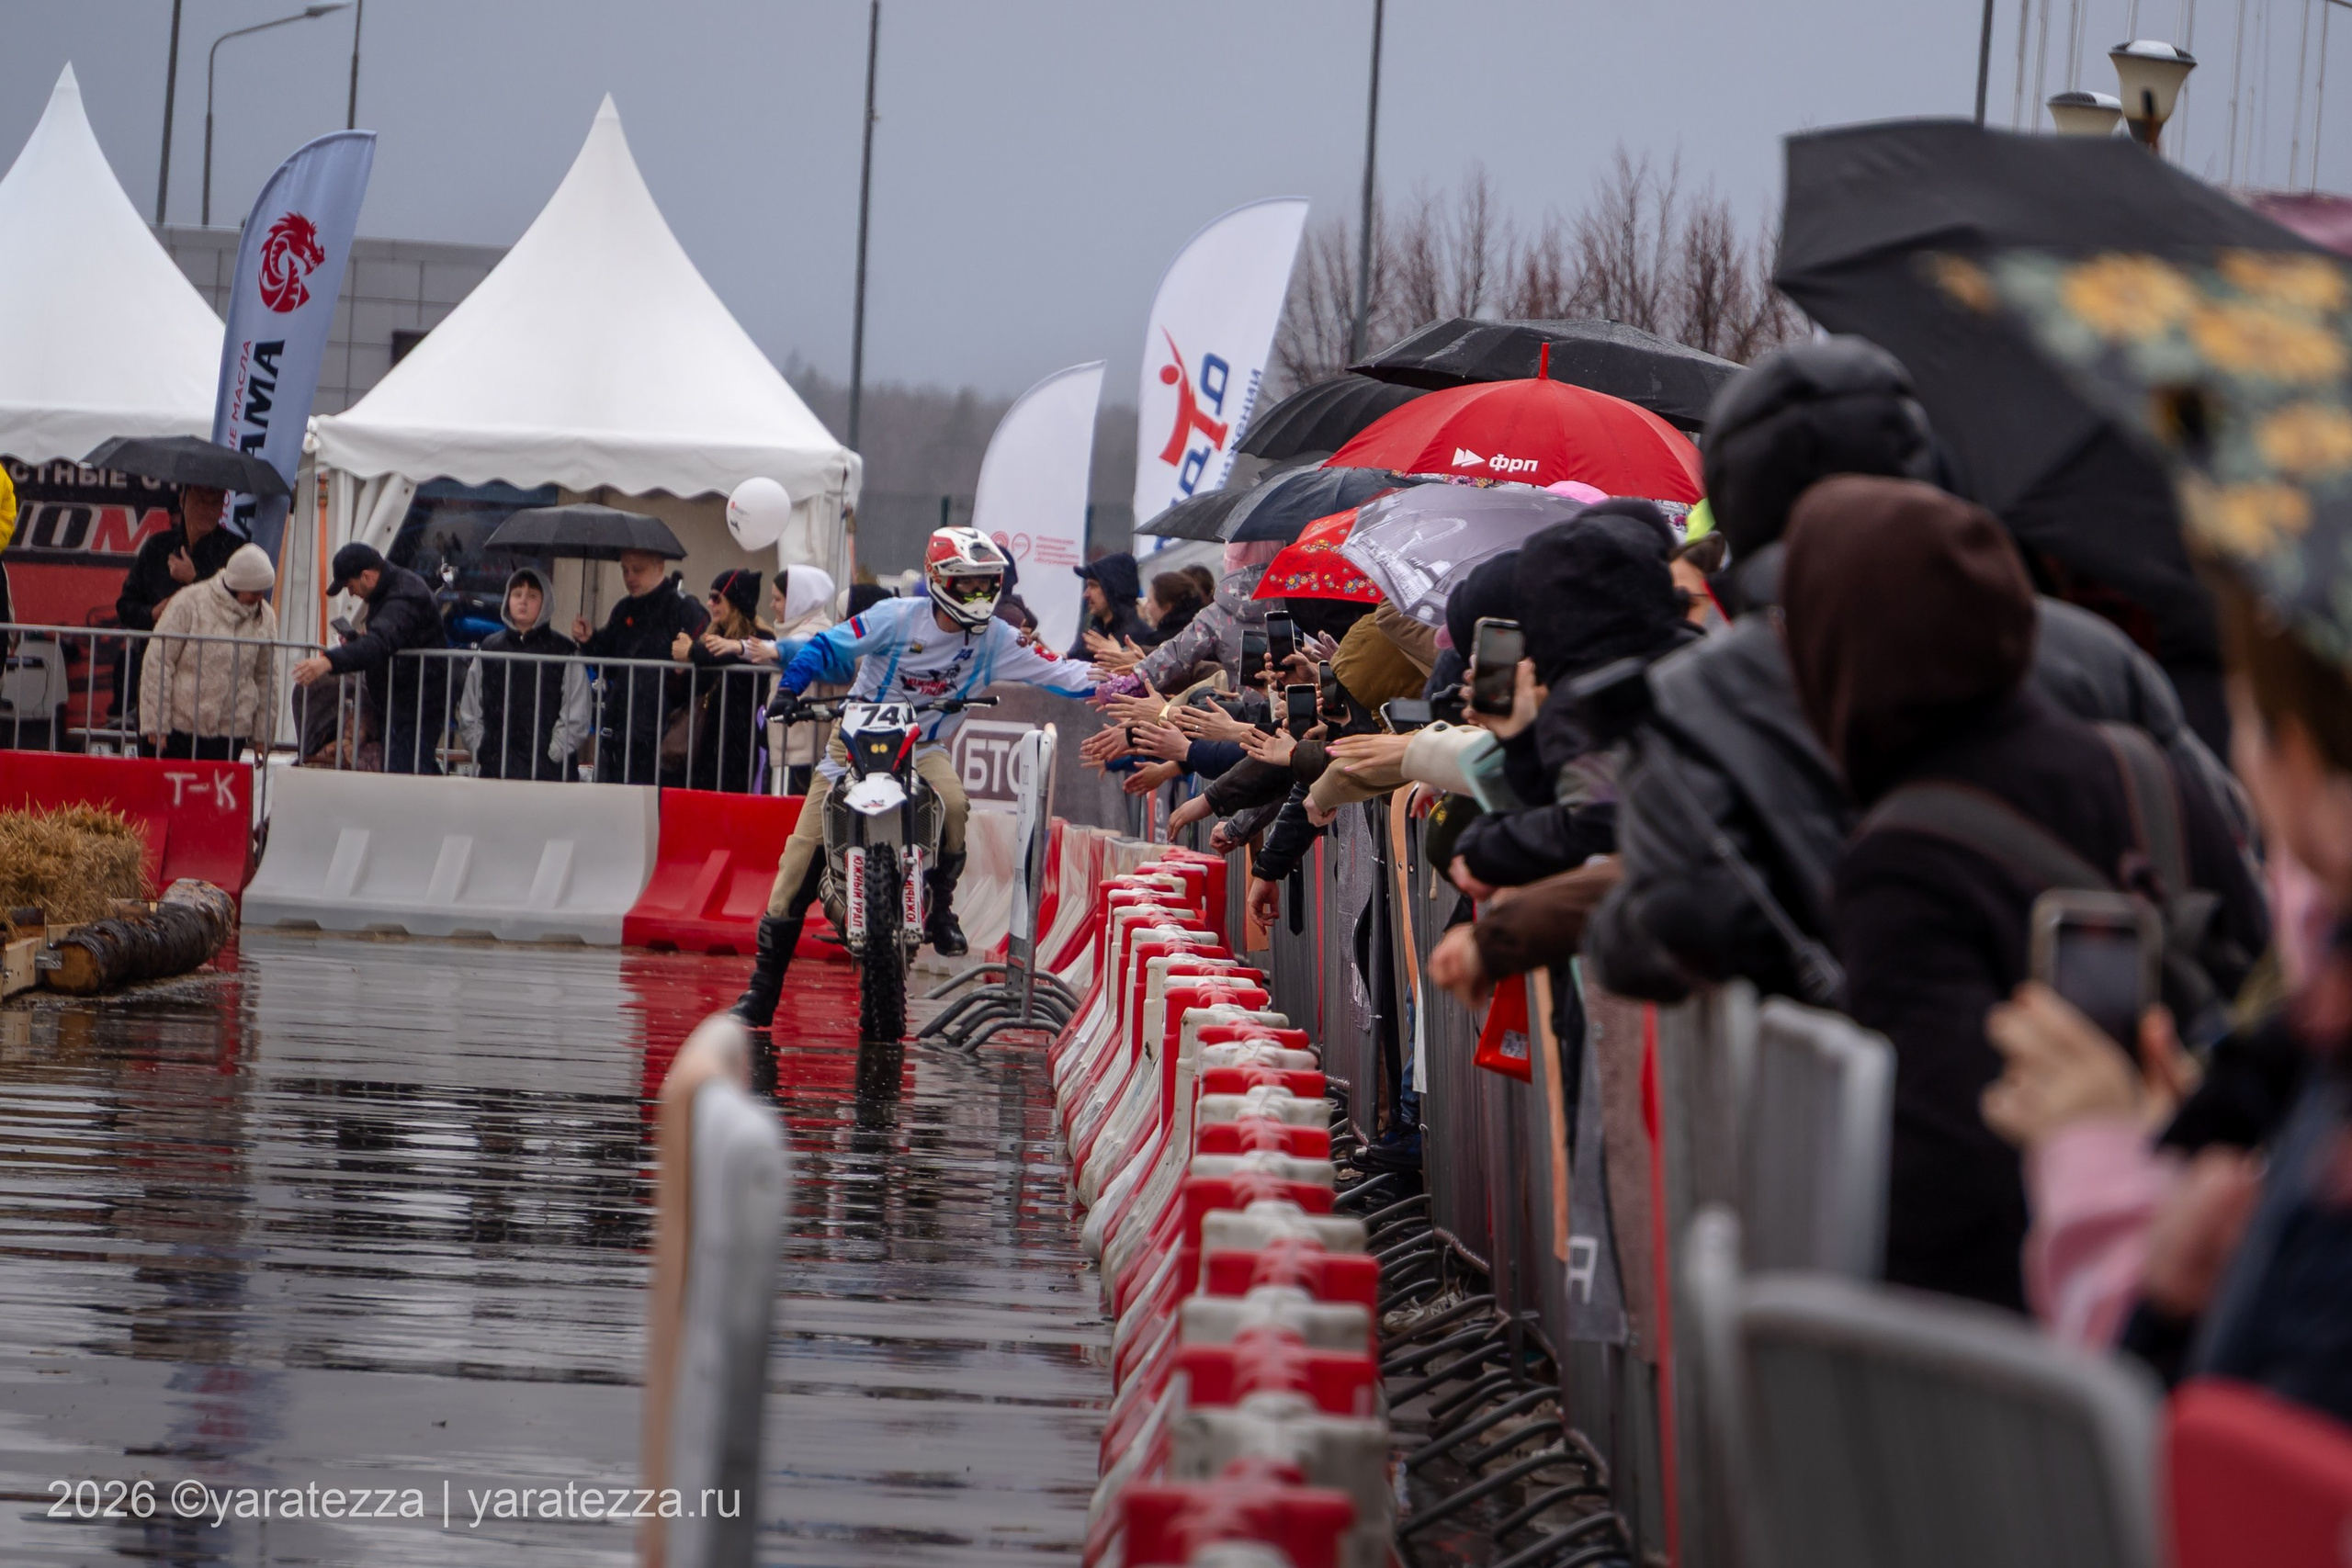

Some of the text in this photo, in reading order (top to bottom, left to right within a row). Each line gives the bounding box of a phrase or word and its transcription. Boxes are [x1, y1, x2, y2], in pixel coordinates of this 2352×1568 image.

[861, 705, 899, 728] 74
[852, 855, 864, 928] ЮЖНЫЙ УРАЛ
[904, 879, 917, 923] ЮЖНЫЙ
